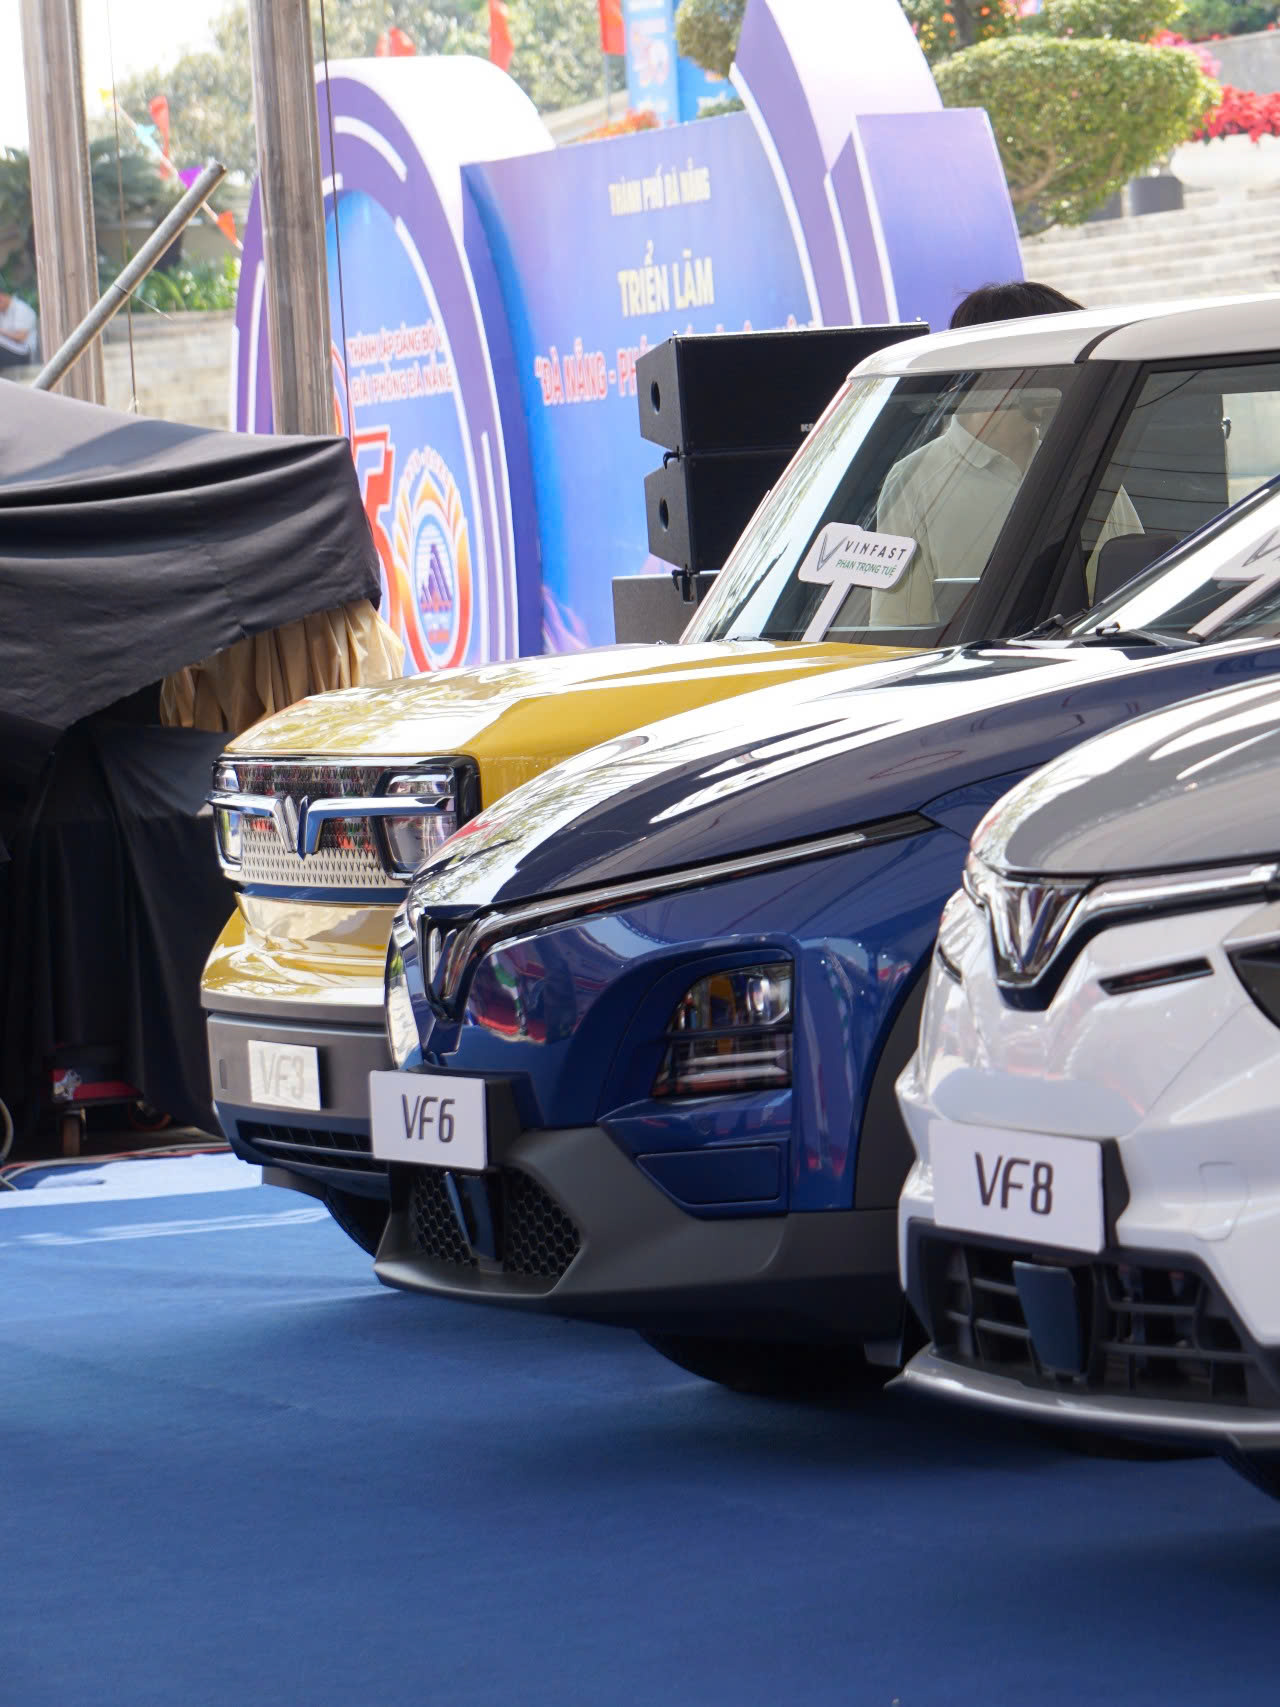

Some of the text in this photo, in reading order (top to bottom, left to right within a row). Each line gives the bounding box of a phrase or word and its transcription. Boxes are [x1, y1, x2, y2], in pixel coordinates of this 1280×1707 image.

[617, 239, 715, 318] TRIỂN LÃM
[835, 559, 898, 578] PHAN TRỌNG TUỆ
[844, 540, 907, 560] VINFAST
[260, 1050, 305, 1098] VF3
[401, 1093, 456, 1143] VF6
[974, 1151, 1054, 1215] VF8
